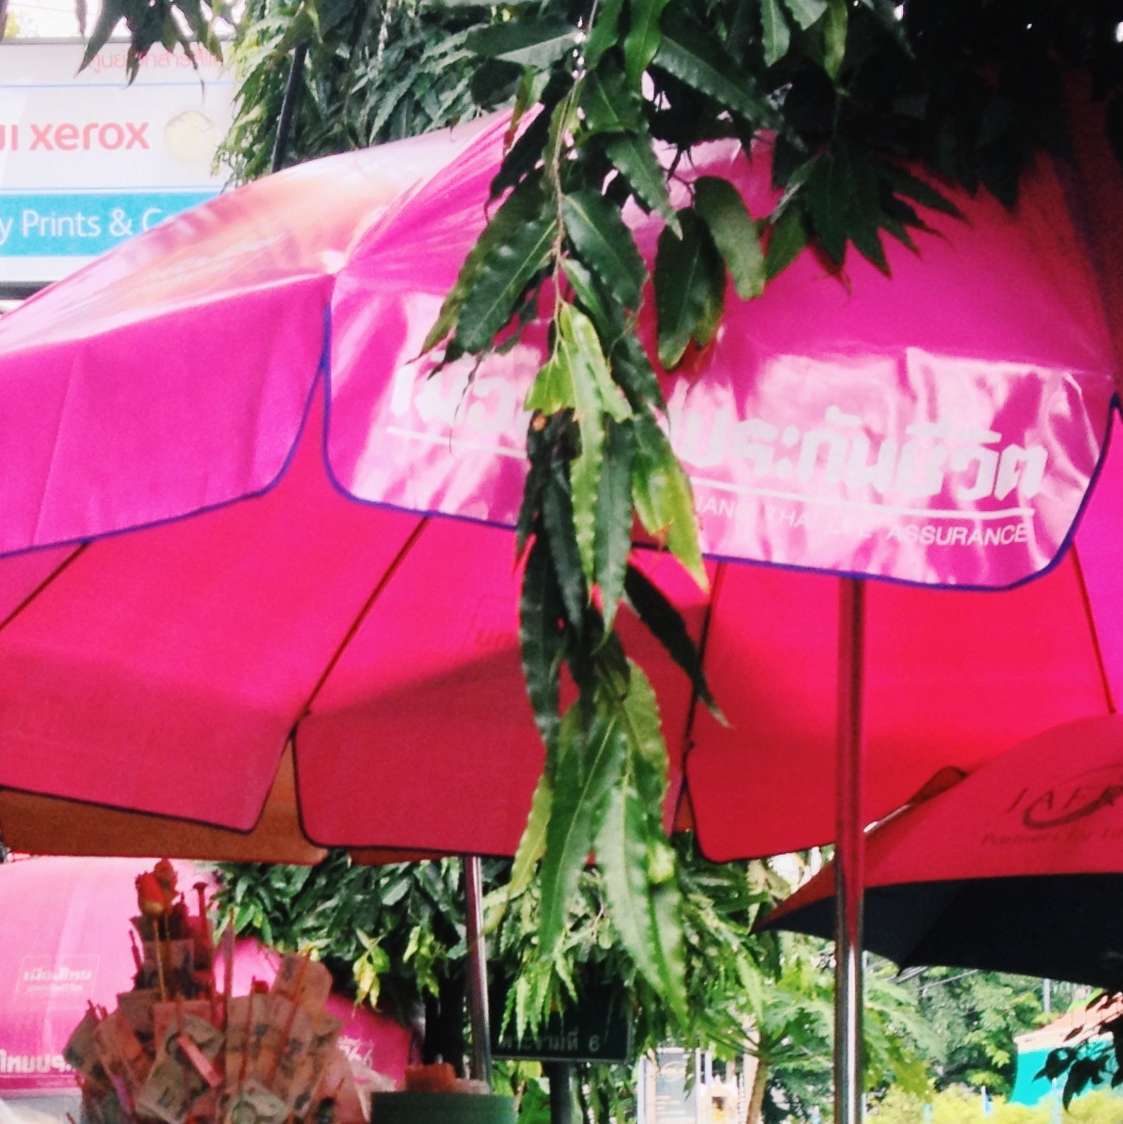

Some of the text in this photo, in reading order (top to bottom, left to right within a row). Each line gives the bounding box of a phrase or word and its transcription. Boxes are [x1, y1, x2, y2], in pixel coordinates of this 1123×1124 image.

[23, 209, 100, 238] Prints
[108, 207, 134, 237] &
[886, 522, 1029, 547] ASSURANCE
[588, 1034, 601, 1053] 6
